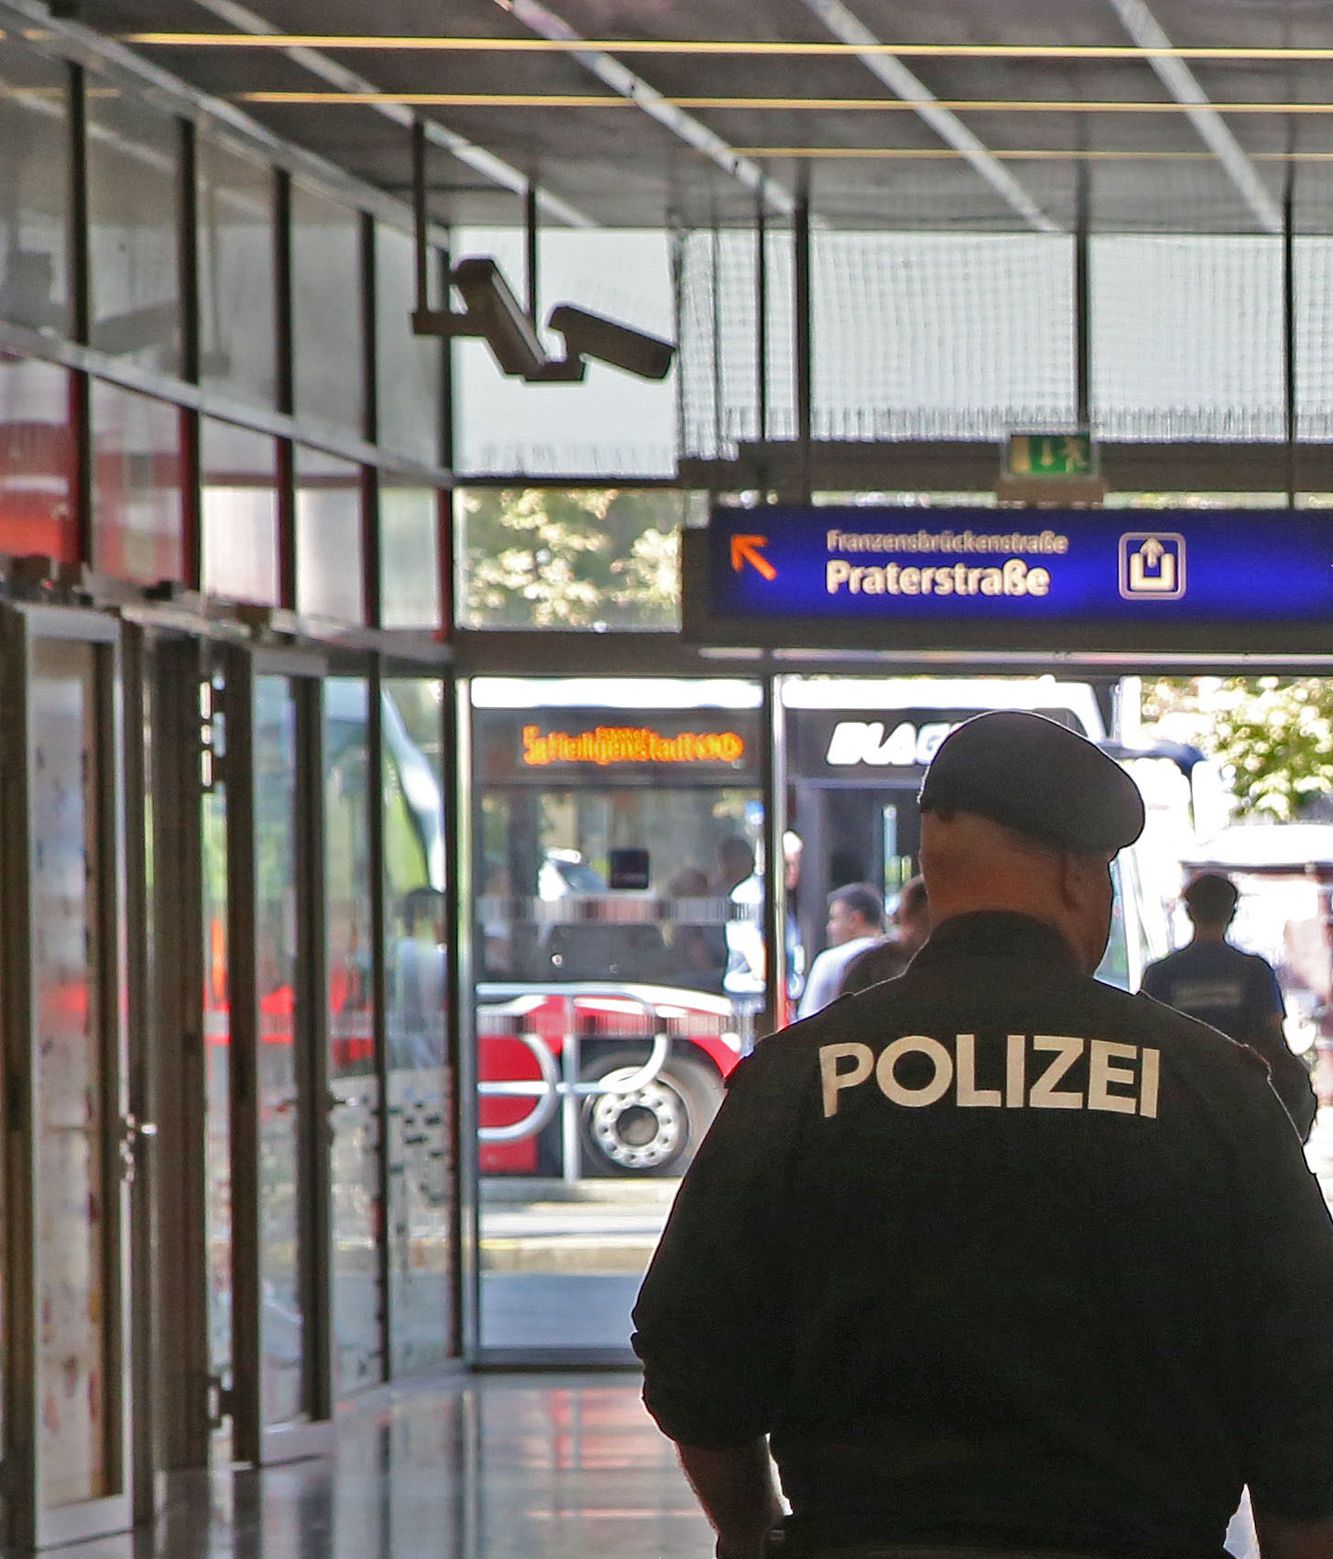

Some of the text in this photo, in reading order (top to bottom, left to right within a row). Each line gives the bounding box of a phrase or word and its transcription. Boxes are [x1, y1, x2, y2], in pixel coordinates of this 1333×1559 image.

[826, 529, 1069, 554] Franzensbrückenstraße
[826, 558, 1050, 596] Praterstraße
[819, 1033, 1160, 1118] POLIZEI
